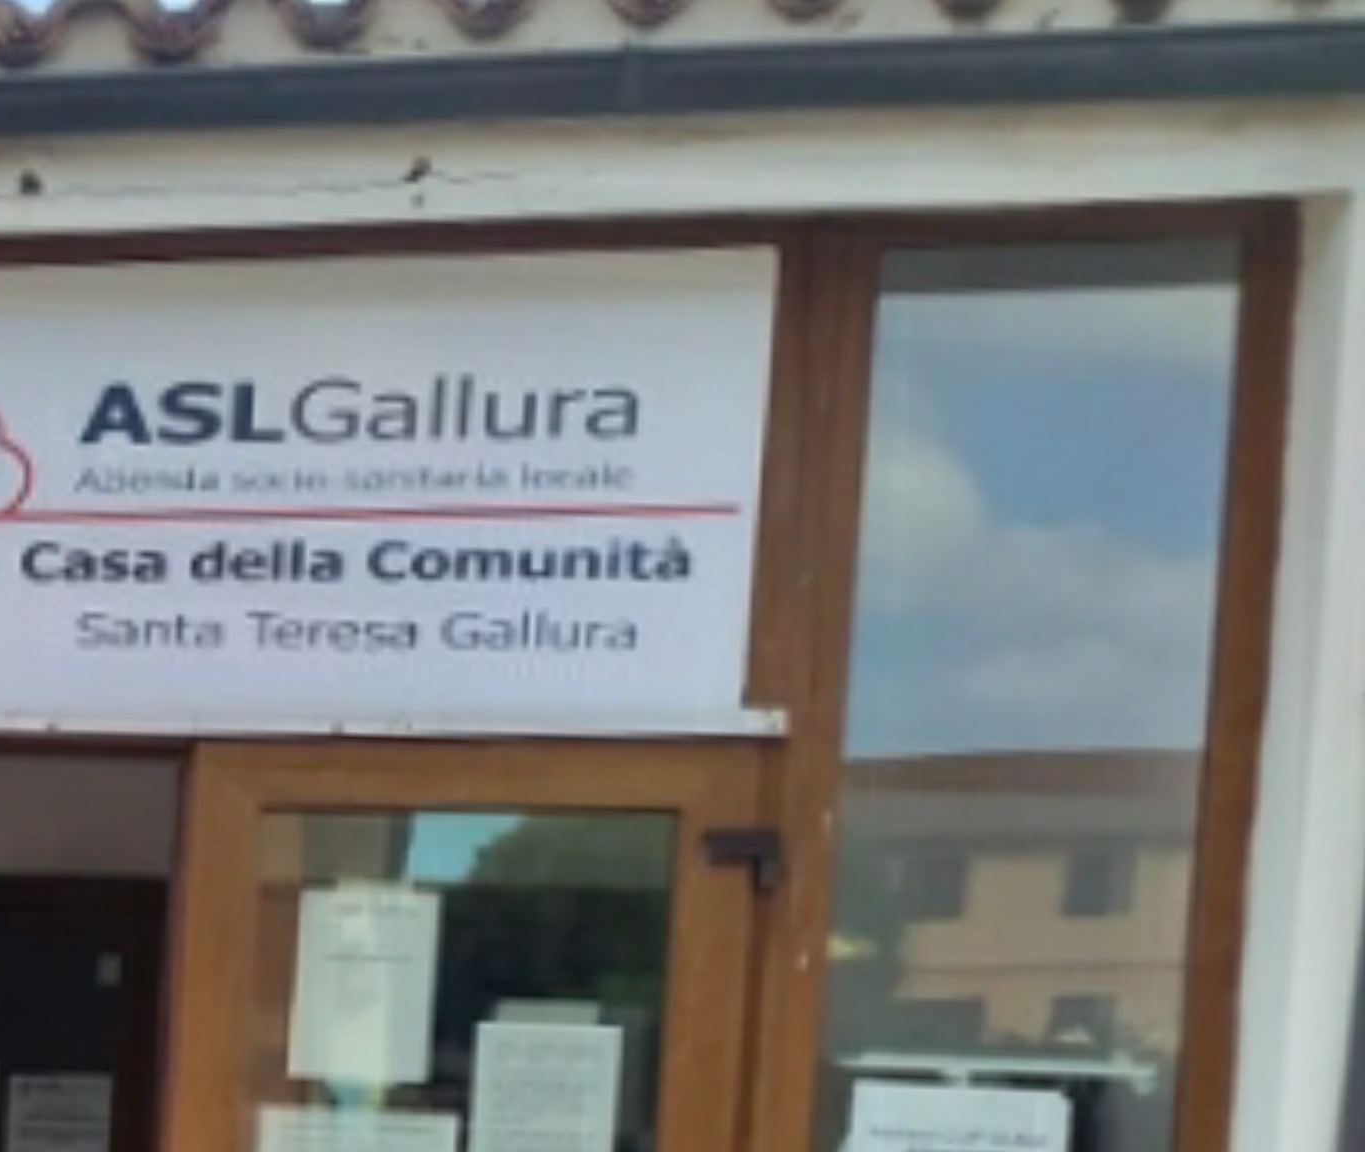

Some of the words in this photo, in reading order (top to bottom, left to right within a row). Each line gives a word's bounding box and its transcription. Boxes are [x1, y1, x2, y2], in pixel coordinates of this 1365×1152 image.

[78, 375, 640, 444] ASLGallura
[20, 541, 166, 583] Casa
[189, 538, 345, 583] della
[367, 535, 693, 583] Comunità
[75, 611, 223, 651] Santa
[248, 609, 418, 651] Teresa
[439, 606, 637, 651] Gallura
